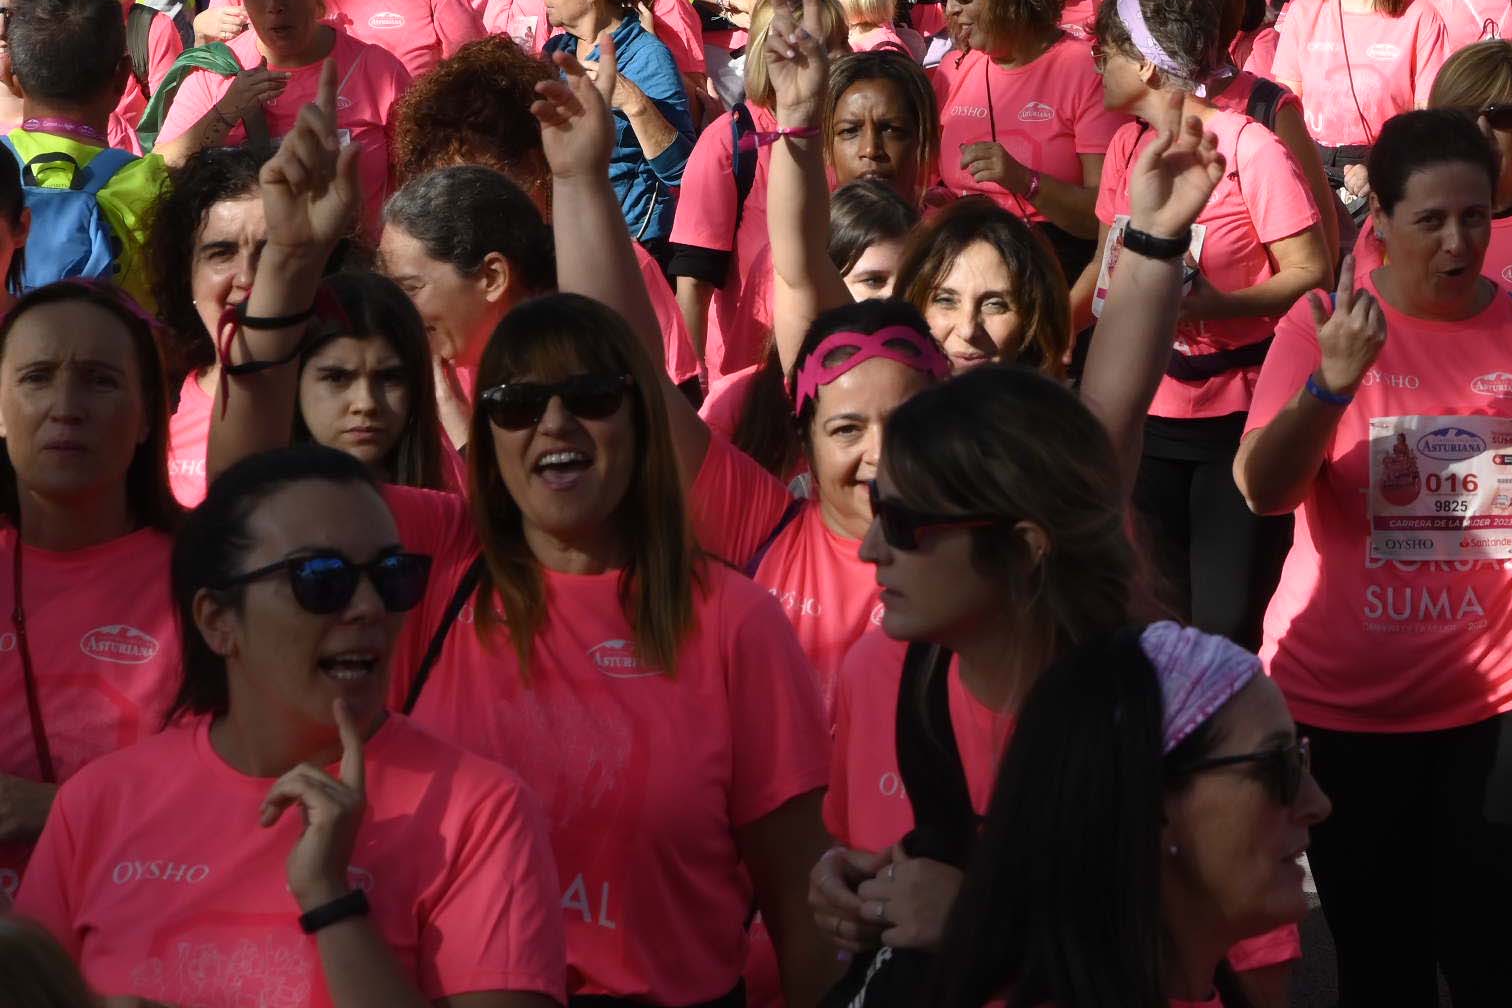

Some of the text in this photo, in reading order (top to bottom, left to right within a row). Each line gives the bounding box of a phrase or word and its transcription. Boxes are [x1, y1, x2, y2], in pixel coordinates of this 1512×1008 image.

[1420, 441, 1482, 453] ASTURIANA
[1425, 473, 1479, 493] 016
[1434, 500, 1468, 512] 9825
[1389, 519, 1432, 528] CARRERA
[1434, 519, 1448, 528] DE
[1449, 519, 1460, 527] LA
[1385, 539, 1434, 550] OYSHO
[1364, 585, 1485, 621] SUMA
[112, 859, 209, 885] OYSHO
